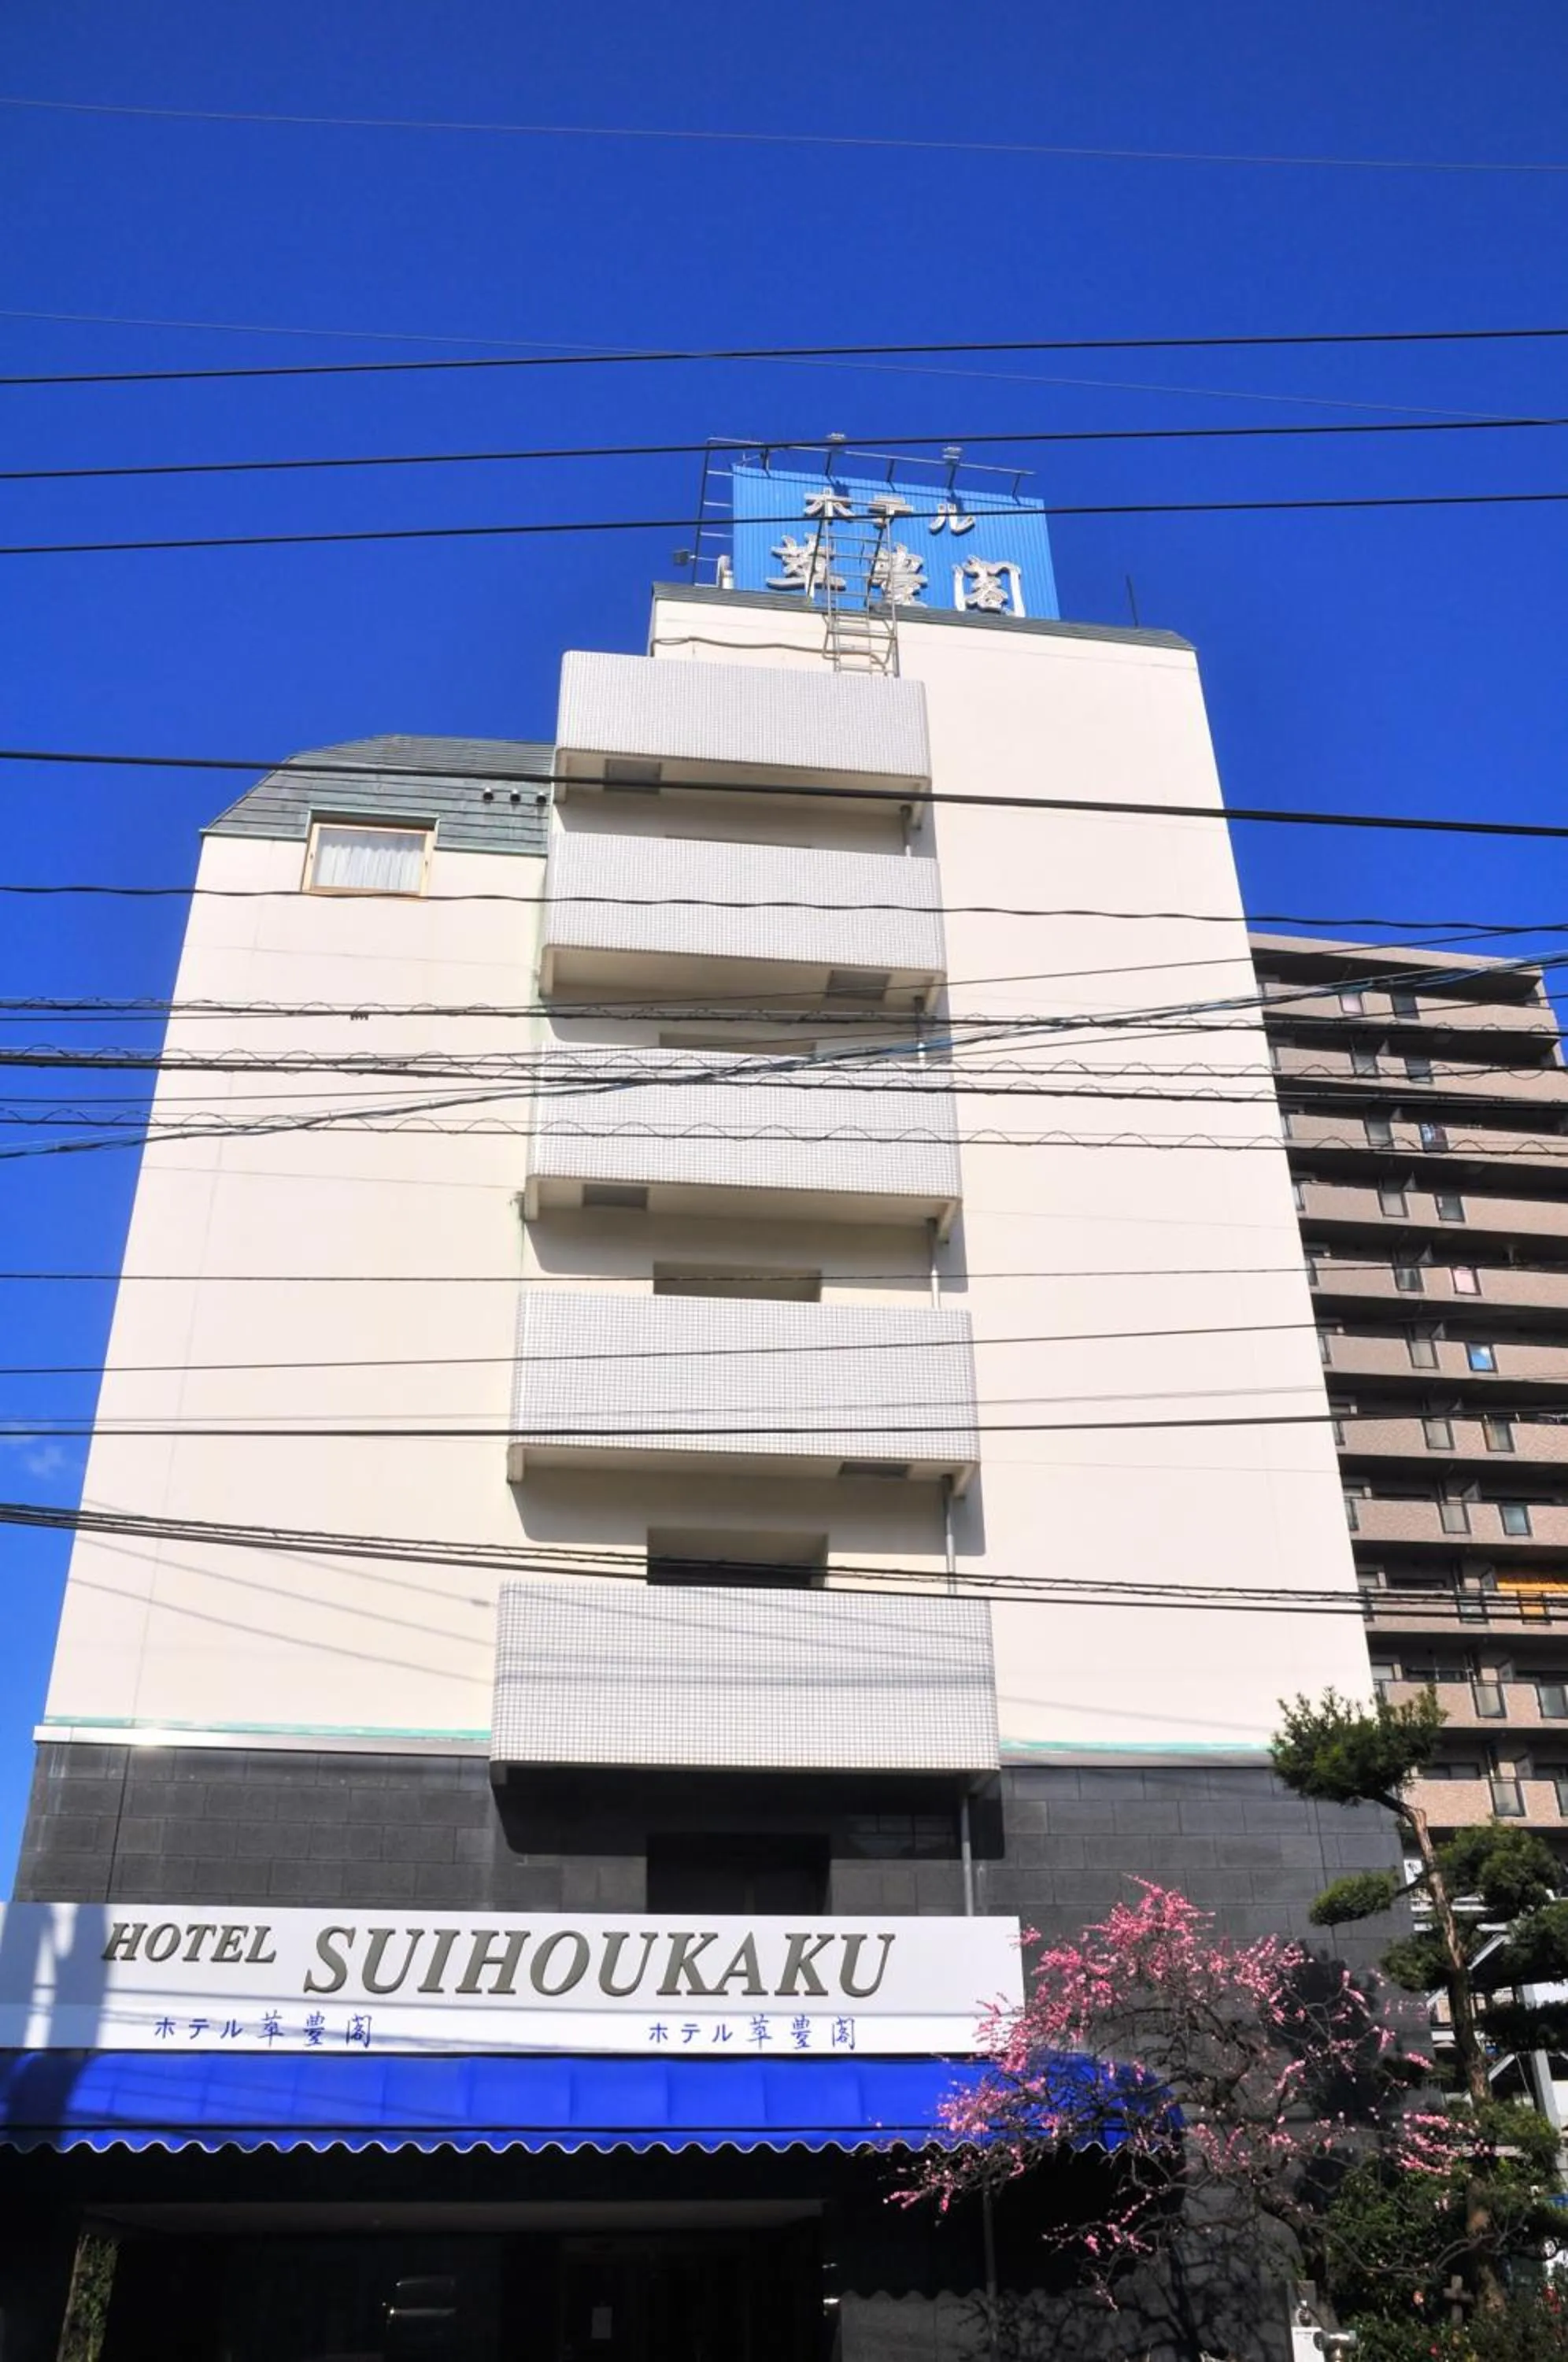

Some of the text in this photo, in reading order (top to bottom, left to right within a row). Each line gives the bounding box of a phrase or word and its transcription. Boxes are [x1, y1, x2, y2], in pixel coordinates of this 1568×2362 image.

[804, 487, 976, 536] ホテル
[102, 1922, 896, 1998] HOTEL SUIHOUKAKU
